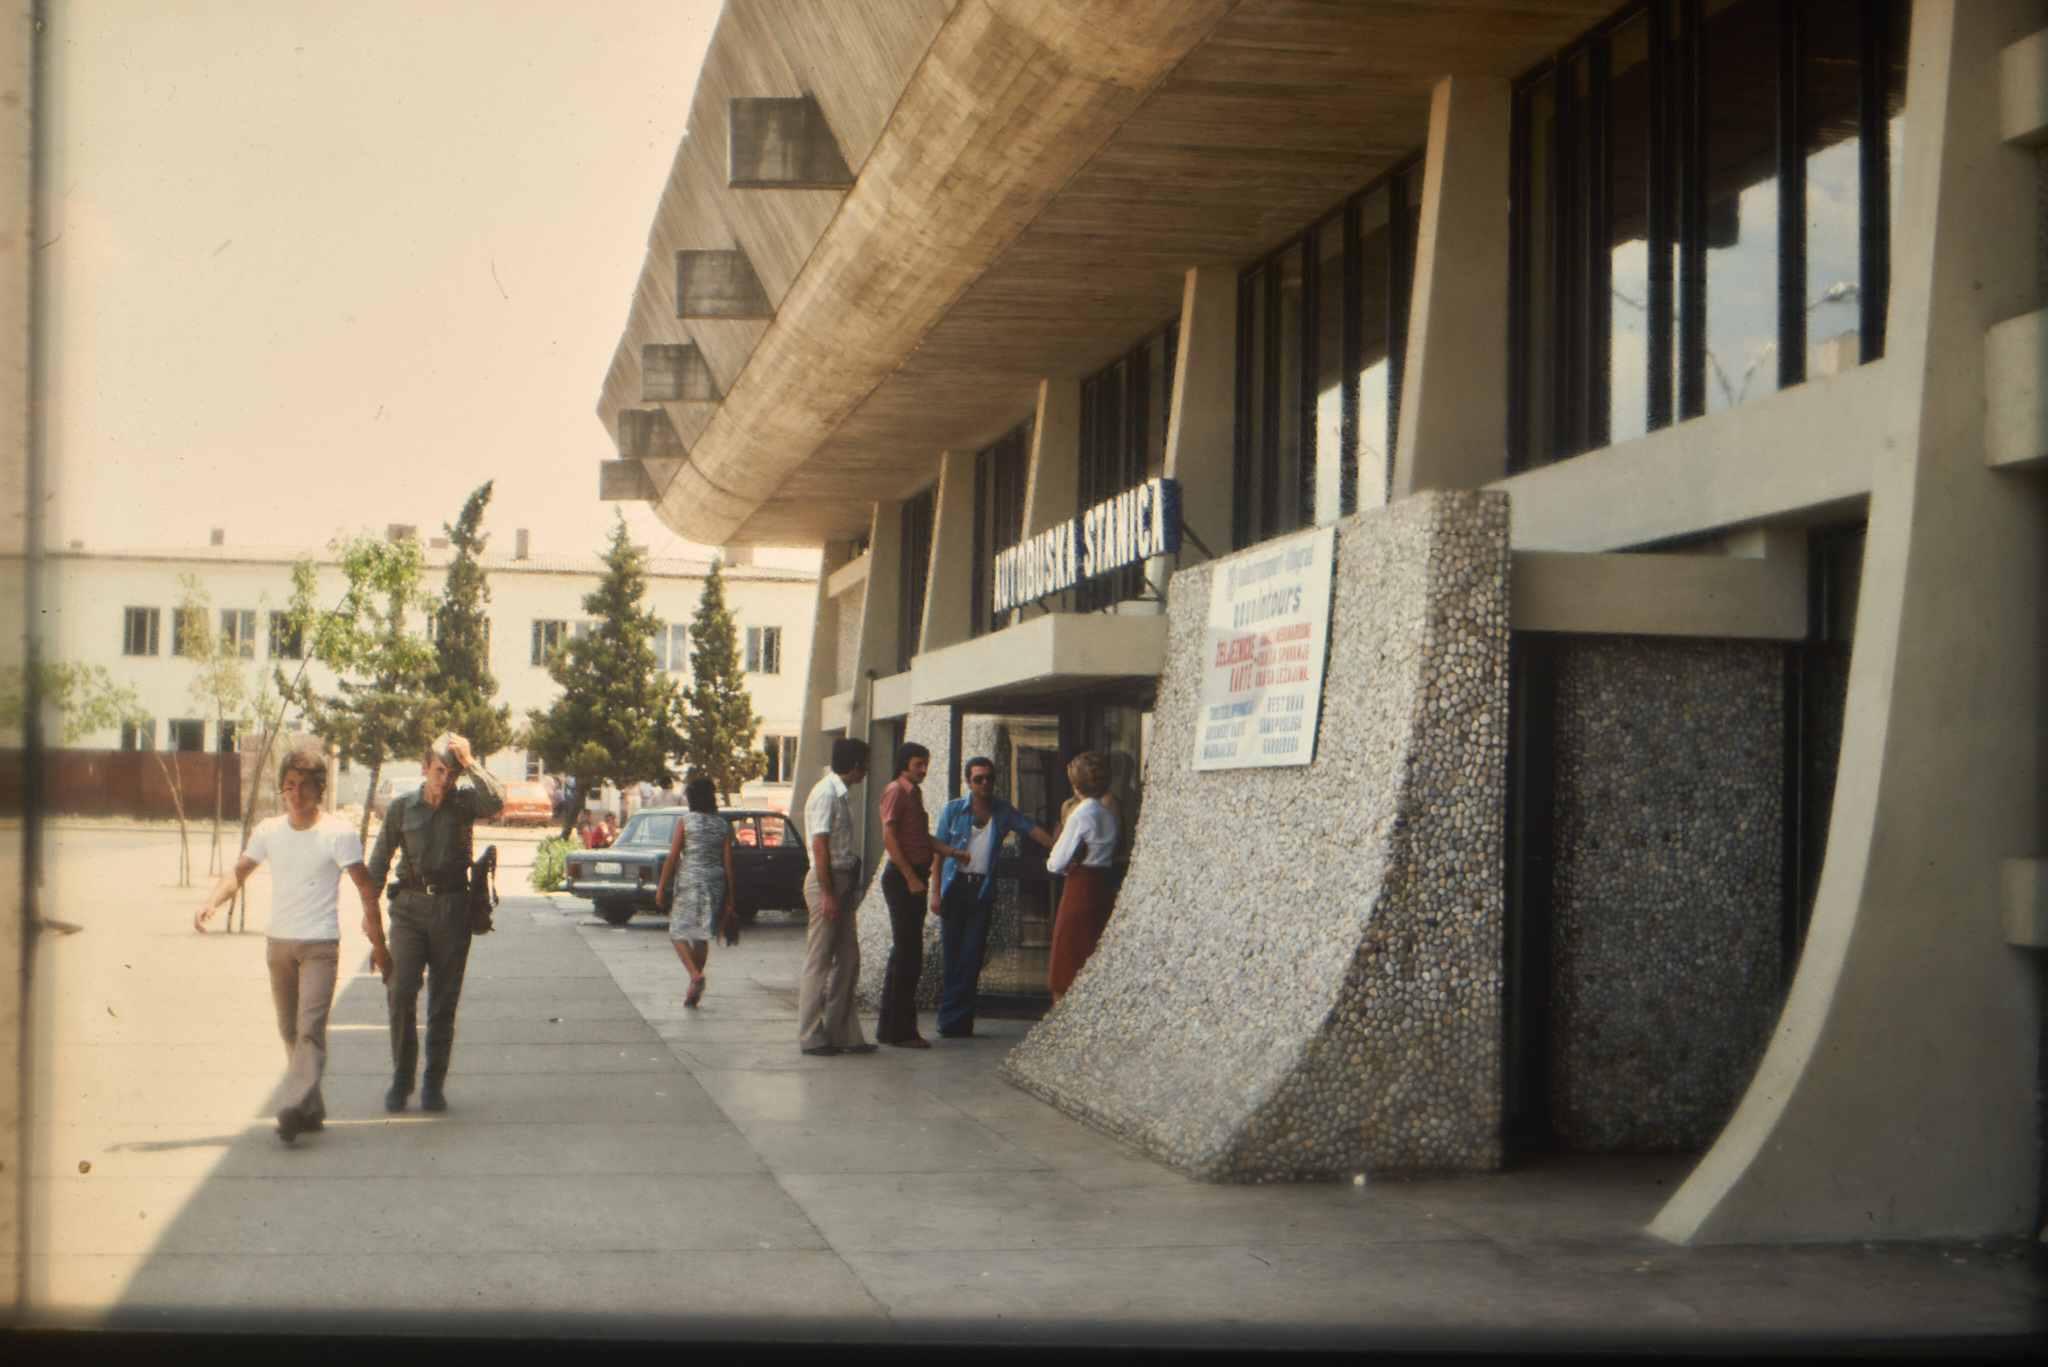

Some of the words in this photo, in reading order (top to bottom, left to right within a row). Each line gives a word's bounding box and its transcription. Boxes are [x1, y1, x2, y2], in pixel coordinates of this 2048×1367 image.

[994, 518, 1077, 613] AUTOBUSKA
[1084, 477, 1164, 578] STANICA
[1267, 694, 1304, 713] RESTORAN
[1259, 715, 1302, 733] SAMOPOSLUGA
